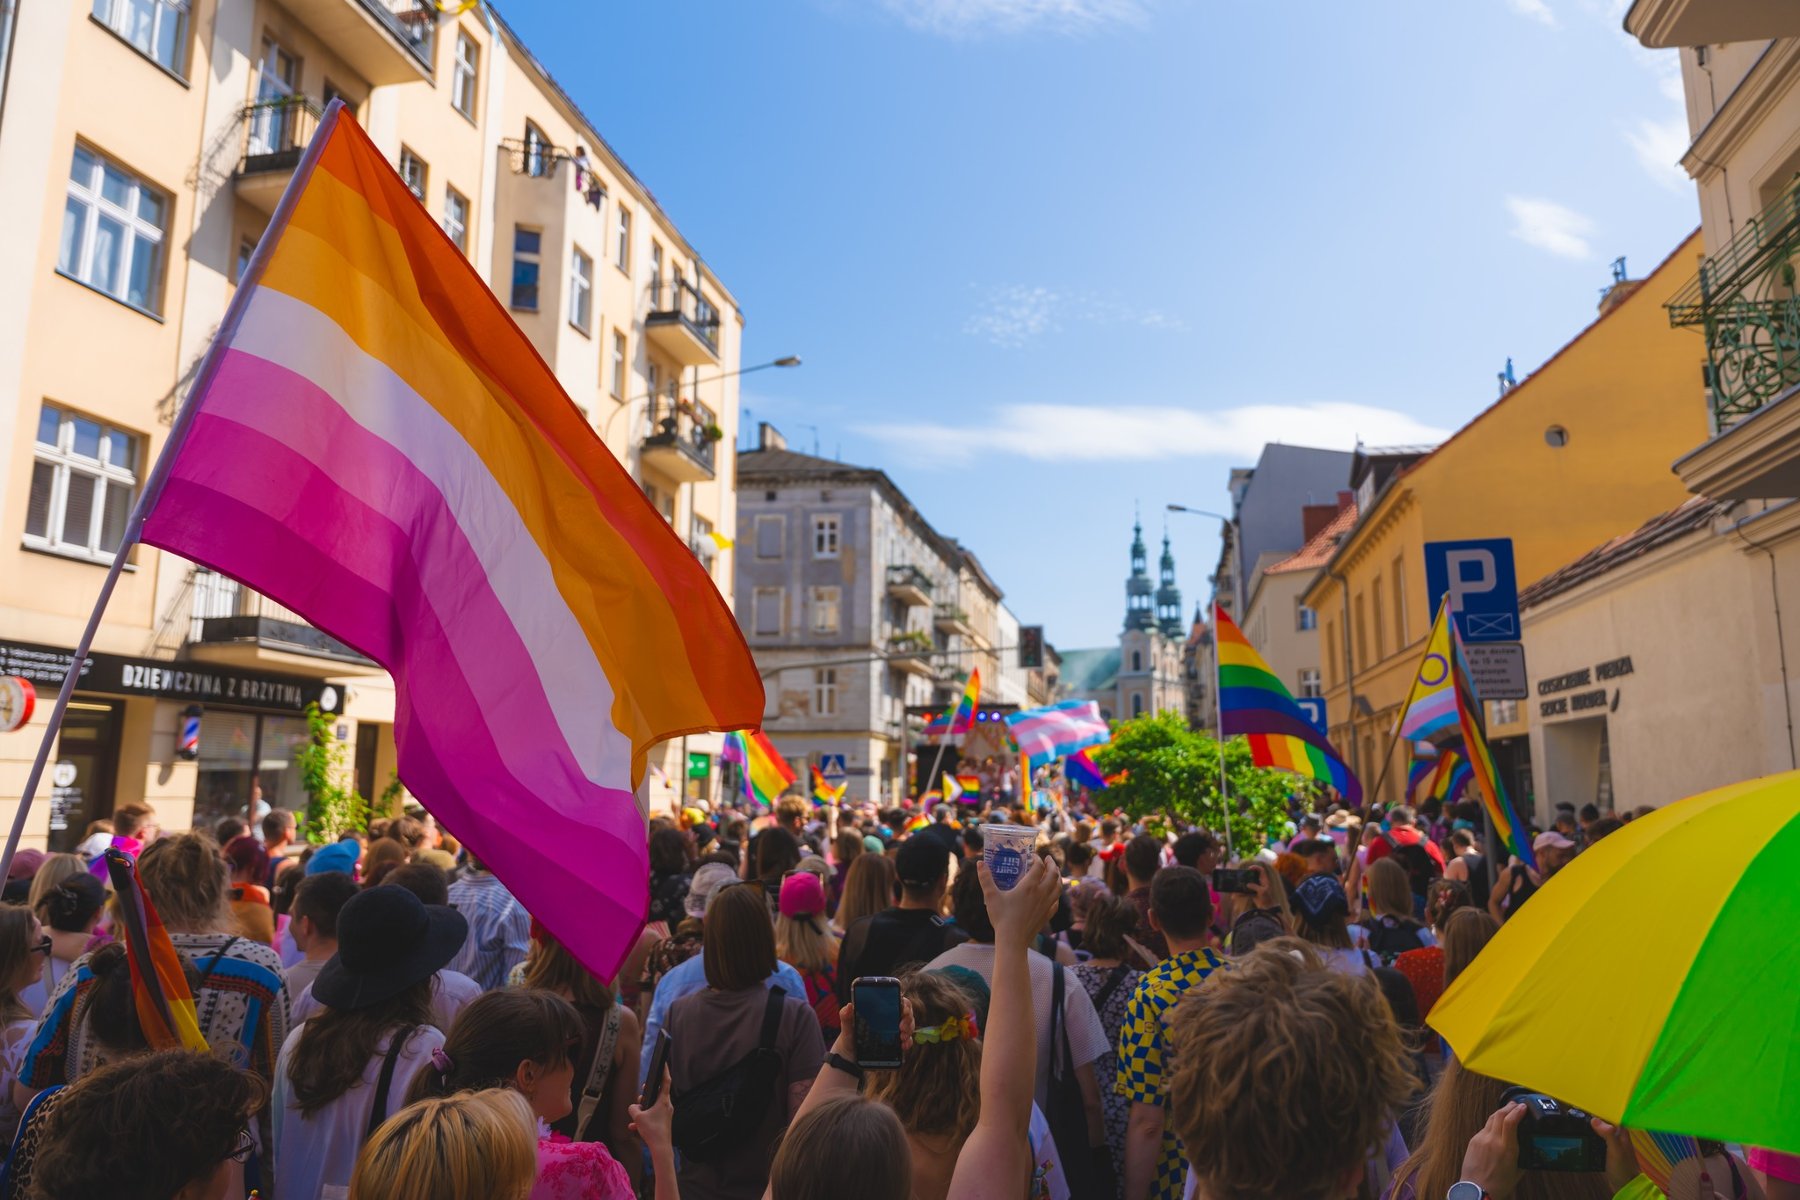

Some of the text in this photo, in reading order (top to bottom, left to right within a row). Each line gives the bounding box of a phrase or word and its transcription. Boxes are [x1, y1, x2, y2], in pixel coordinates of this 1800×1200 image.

[1446, 549, 1497, 612] P
[122, 664, 221, 695] DZIEWCZYNA
[226, 677, 236, 697] Z
[239, 680, 302, 708] BRZYTWĄ
